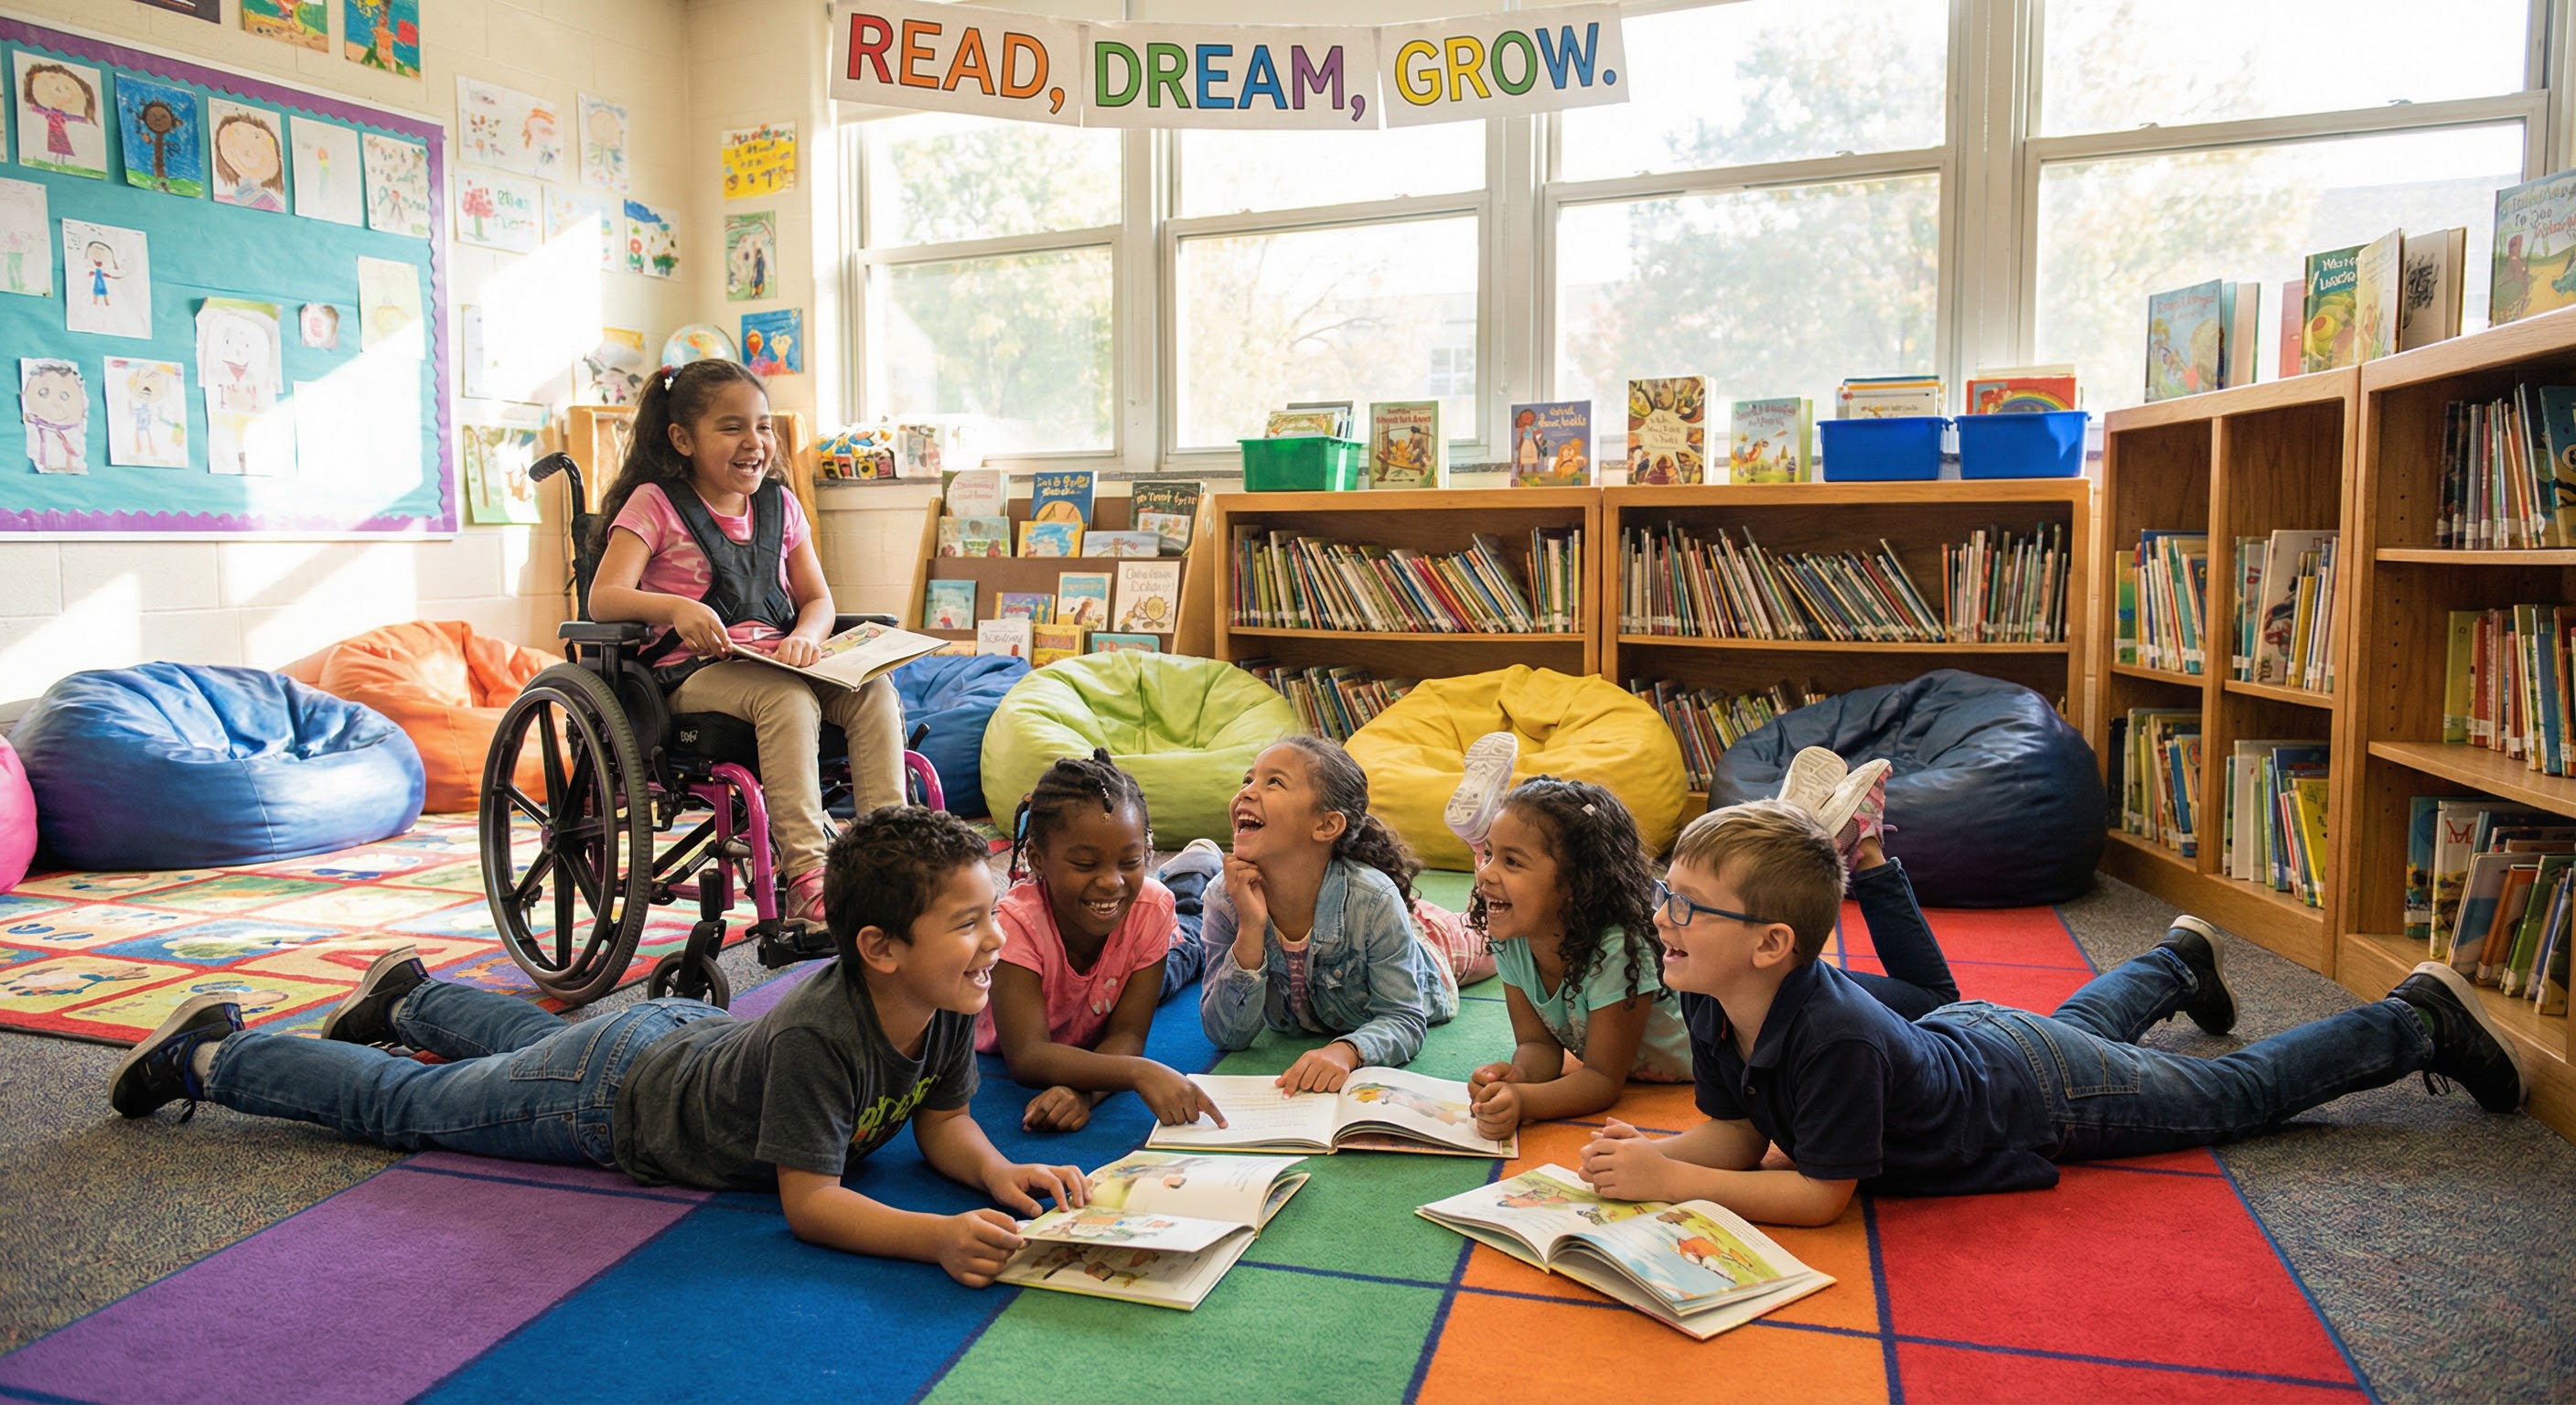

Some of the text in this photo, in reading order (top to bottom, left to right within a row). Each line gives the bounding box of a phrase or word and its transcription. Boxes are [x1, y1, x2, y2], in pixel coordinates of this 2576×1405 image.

[847, 13, 1616, 122] READ, DREAM, GROW.
